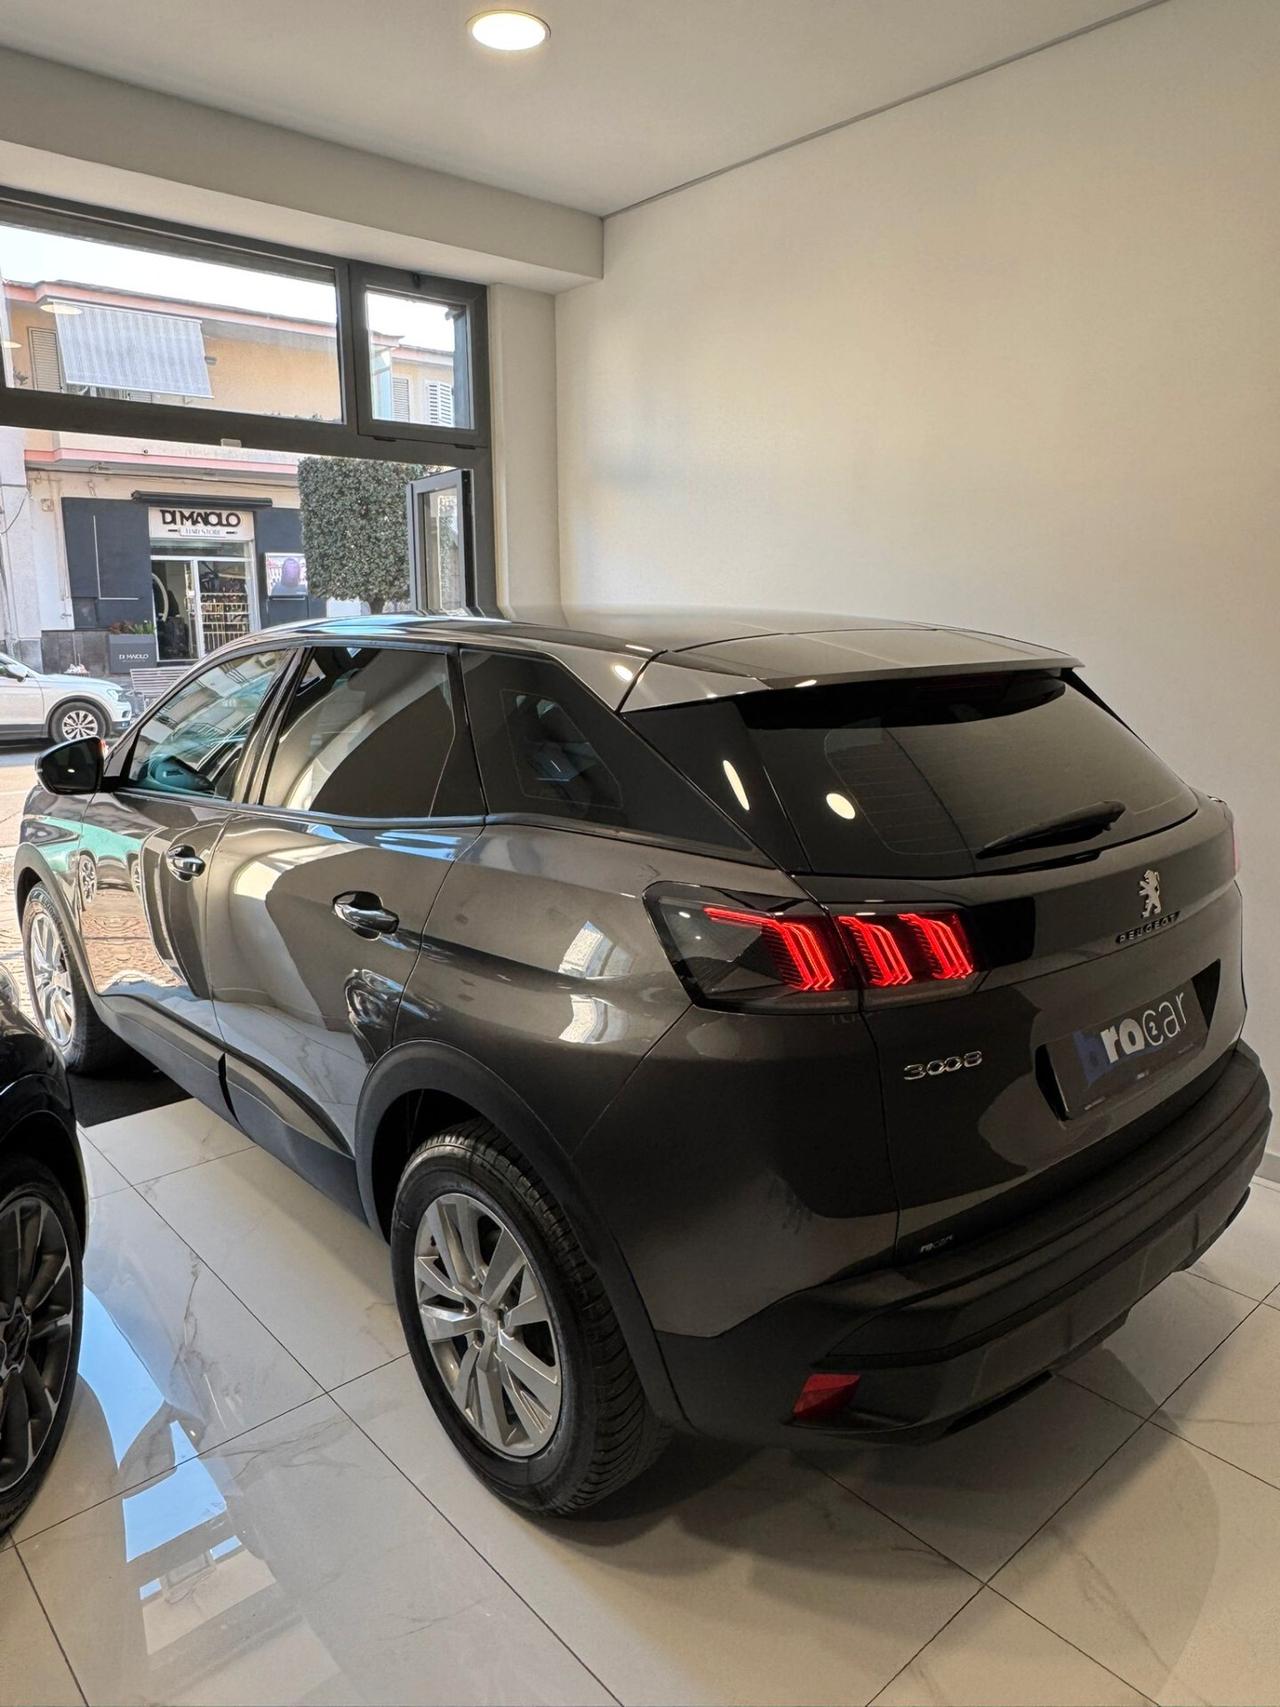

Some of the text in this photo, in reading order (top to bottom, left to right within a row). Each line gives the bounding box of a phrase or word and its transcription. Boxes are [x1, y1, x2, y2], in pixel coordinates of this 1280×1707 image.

[160, 509, 241, 528] DI MAIOLO
[1118, 913, 1178, 944] PEUGEOT
[903, 1050, 983, 1081] 3008
